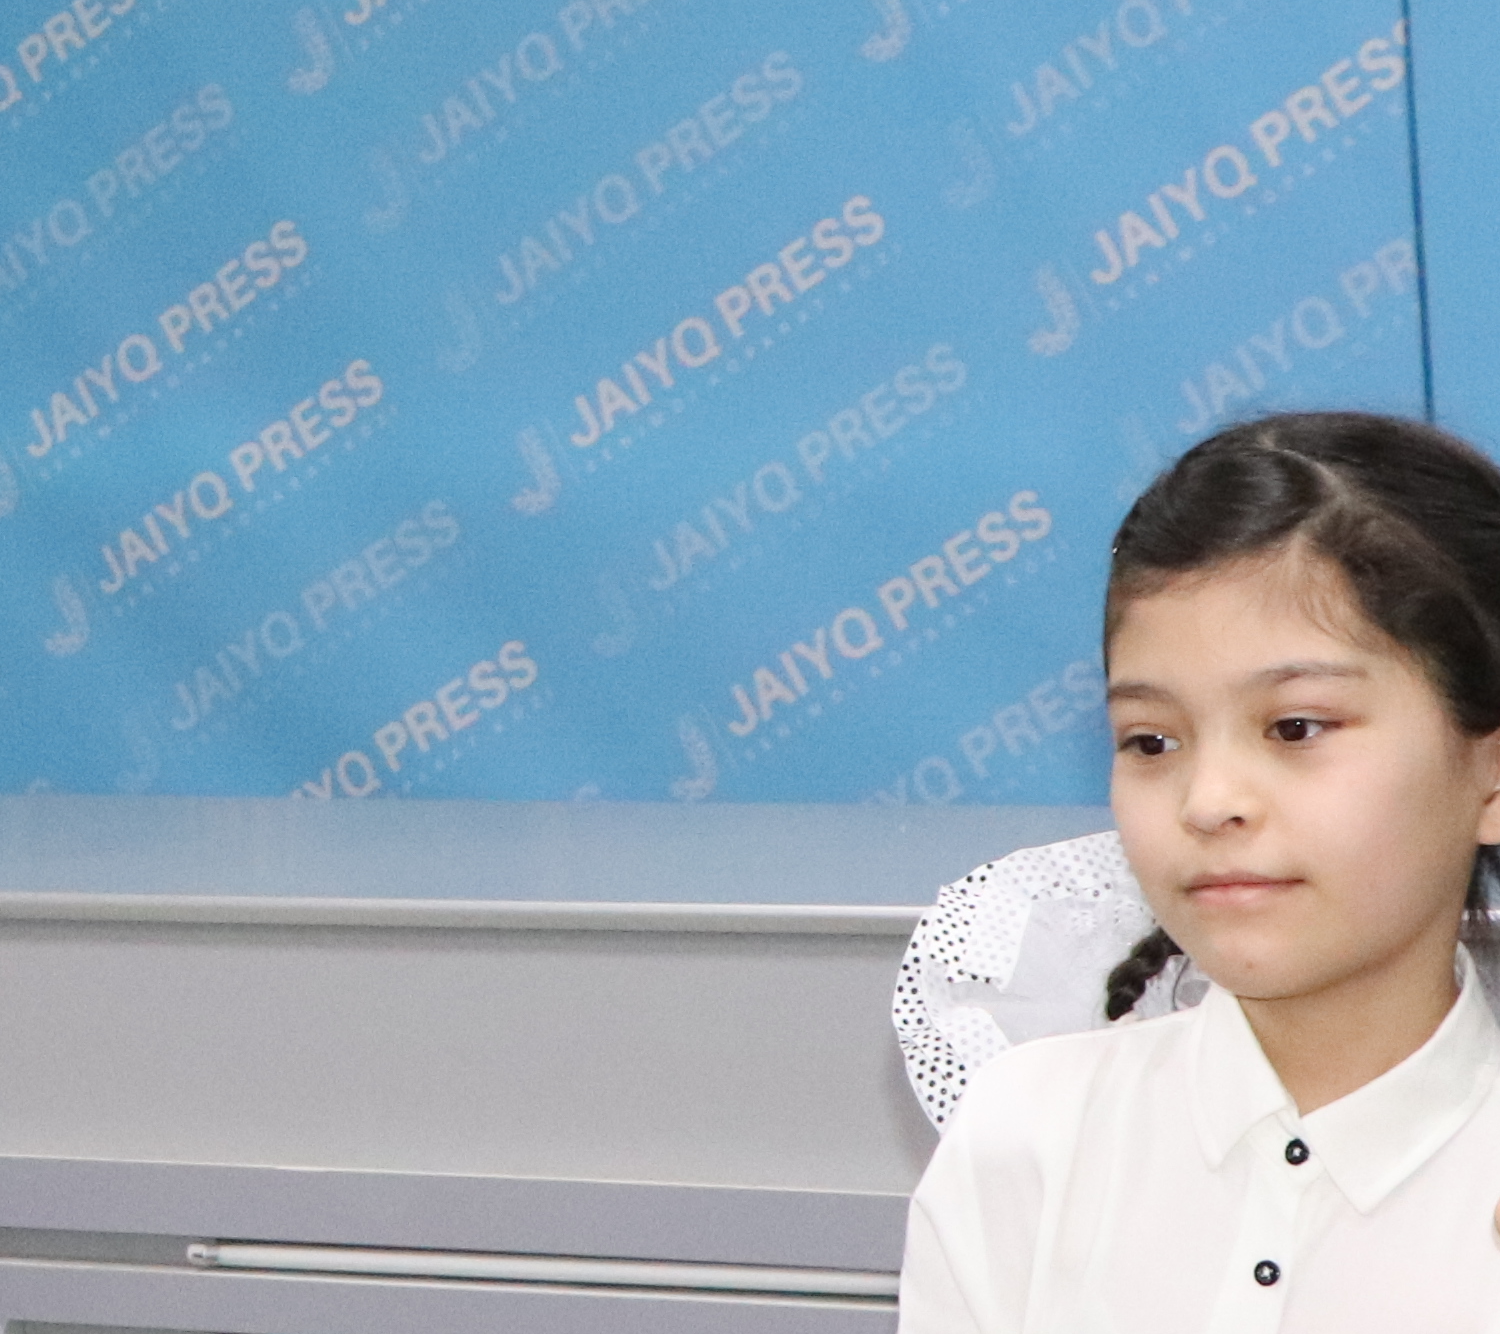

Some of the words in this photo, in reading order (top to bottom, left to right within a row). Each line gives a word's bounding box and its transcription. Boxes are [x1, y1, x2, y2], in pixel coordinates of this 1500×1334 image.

[571, 317, 722, 448] JAIYQ
[715, 194, 885, 337] PRESS
[1090, 144, 1258, 285] JAIYQ
[25, 333, 161, 457] JAIYQ
[159, 219, 308, 353] PRESS
[100, 471, 234, 594] JAIYQ
[230, 359, 384, 492] PRESS
[375, 639, 539, 772] PRESS
[728, 607, 885, 739] JAIYQ
[877, 490, 1052, 632] PRESS
